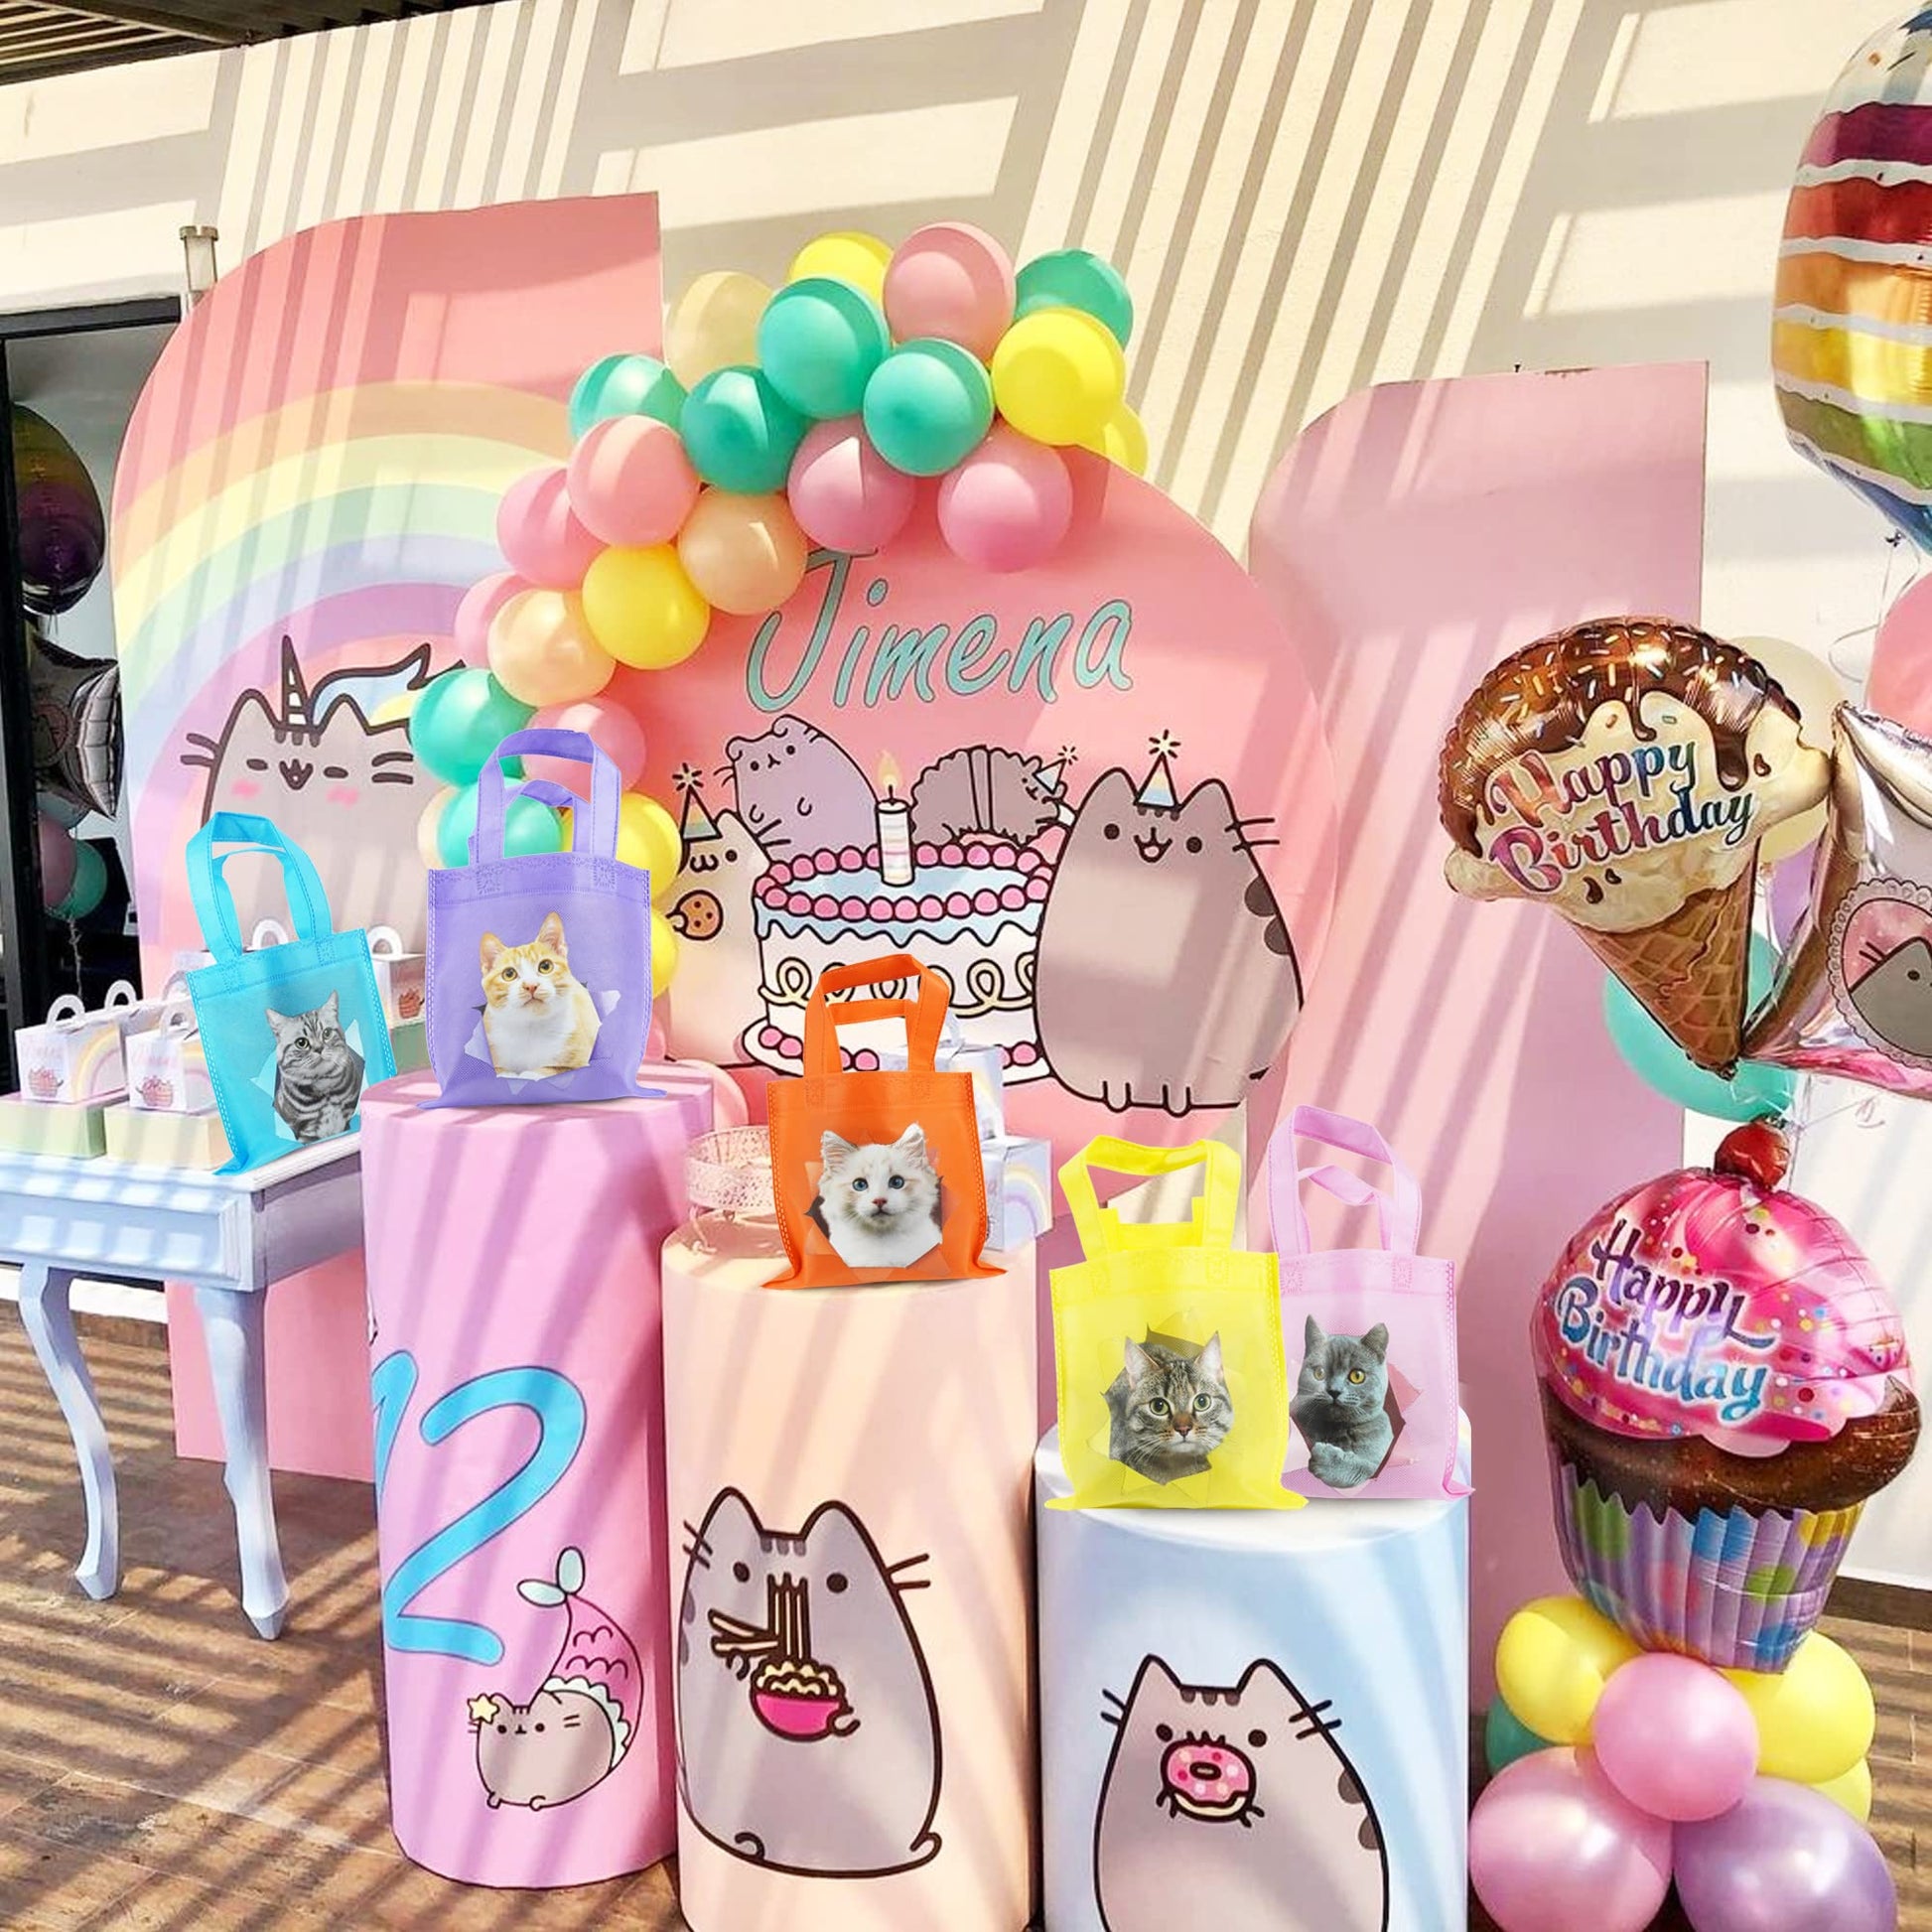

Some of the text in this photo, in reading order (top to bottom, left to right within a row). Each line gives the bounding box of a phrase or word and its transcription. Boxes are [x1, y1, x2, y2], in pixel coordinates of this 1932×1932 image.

[747, 547, 1134, 714] Jimena
[1489, 787, 1754, 893] Birthday
[1490, 740, 1697, 828] Happy
[1558, 1275, 1768, 1423] Birthday
[1590, 1218, 1775, 1349] Happy
